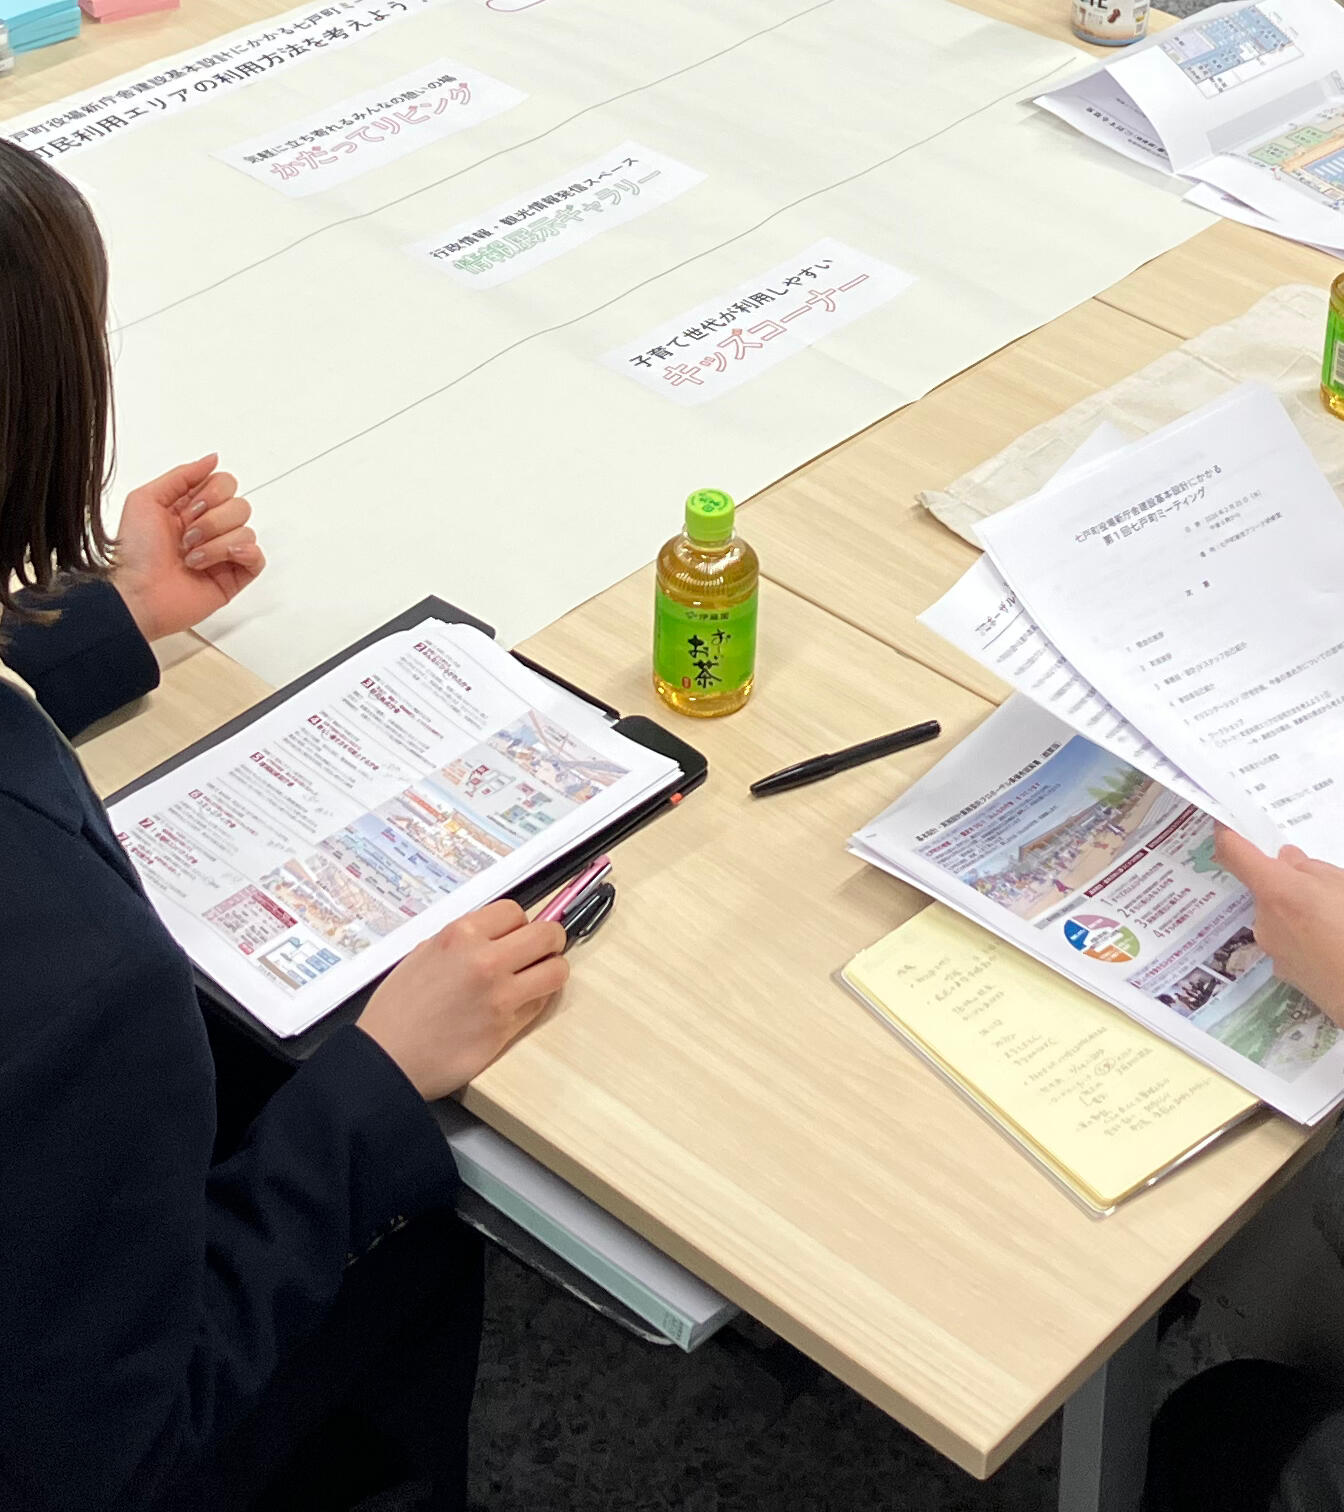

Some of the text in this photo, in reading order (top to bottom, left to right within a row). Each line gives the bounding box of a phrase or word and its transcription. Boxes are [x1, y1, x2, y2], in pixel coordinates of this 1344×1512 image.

[270, 82, 473, 180] かだってリビング
[429, 157, 639, 260] 行政情報・観光情報発信スペース
[455, 169, 662, 275] 情報展示ギャラリー
[629, 259, 833, 368] 子育て世代が利用しやすい
[663, 273, 870, 387] キッズコーナー
[687, 634, 723, 689] お茶
